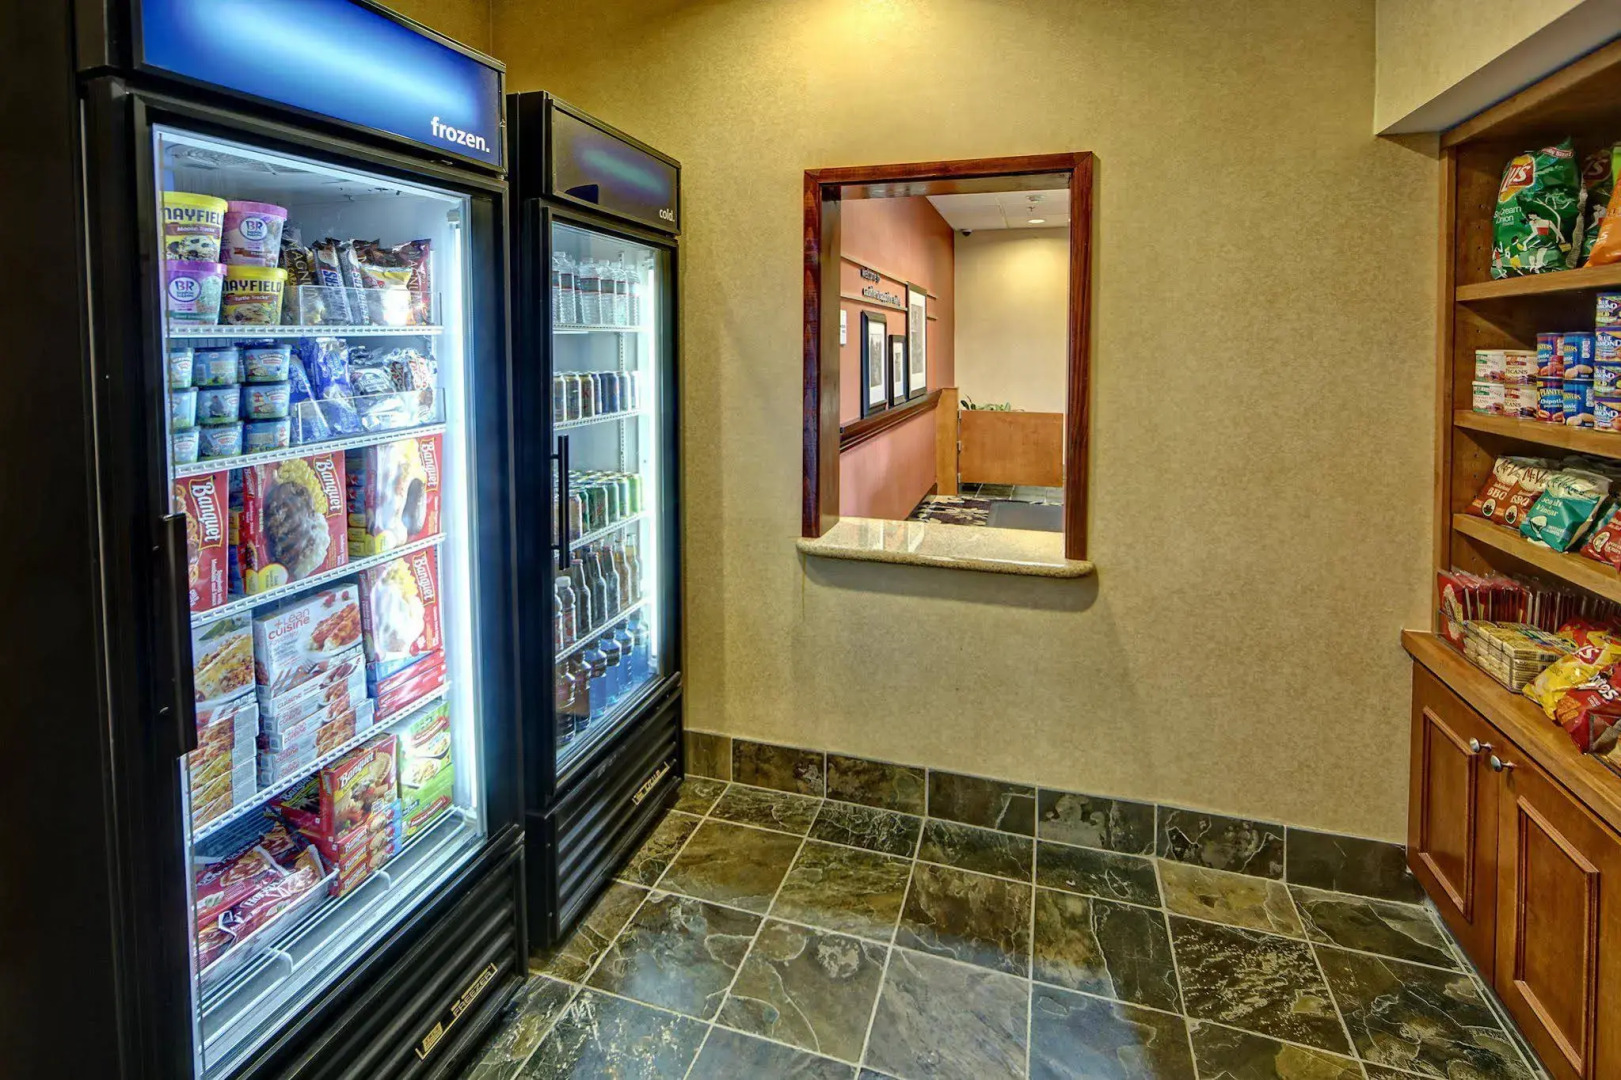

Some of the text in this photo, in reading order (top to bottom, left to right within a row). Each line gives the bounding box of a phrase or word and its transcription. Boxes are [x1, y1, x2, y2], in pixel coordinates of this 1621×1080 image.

[430, 116, 490, 153] frozen.
[246, 220, 263, 231] BR
[659, 208, 675, 222] cold.
[175, 281, 195, 291] BR
[422, 441, 437, 488] Banquet
[315, 460, 342, 512] Banquet
[191, 482, 220, 543] Banquet
[414, 556, 434, 601] Banquet
[284, 608, 310, 627] Lean
[282, 774, 315, 802] Banquet
[338, 754, 375, 788] Banquet
